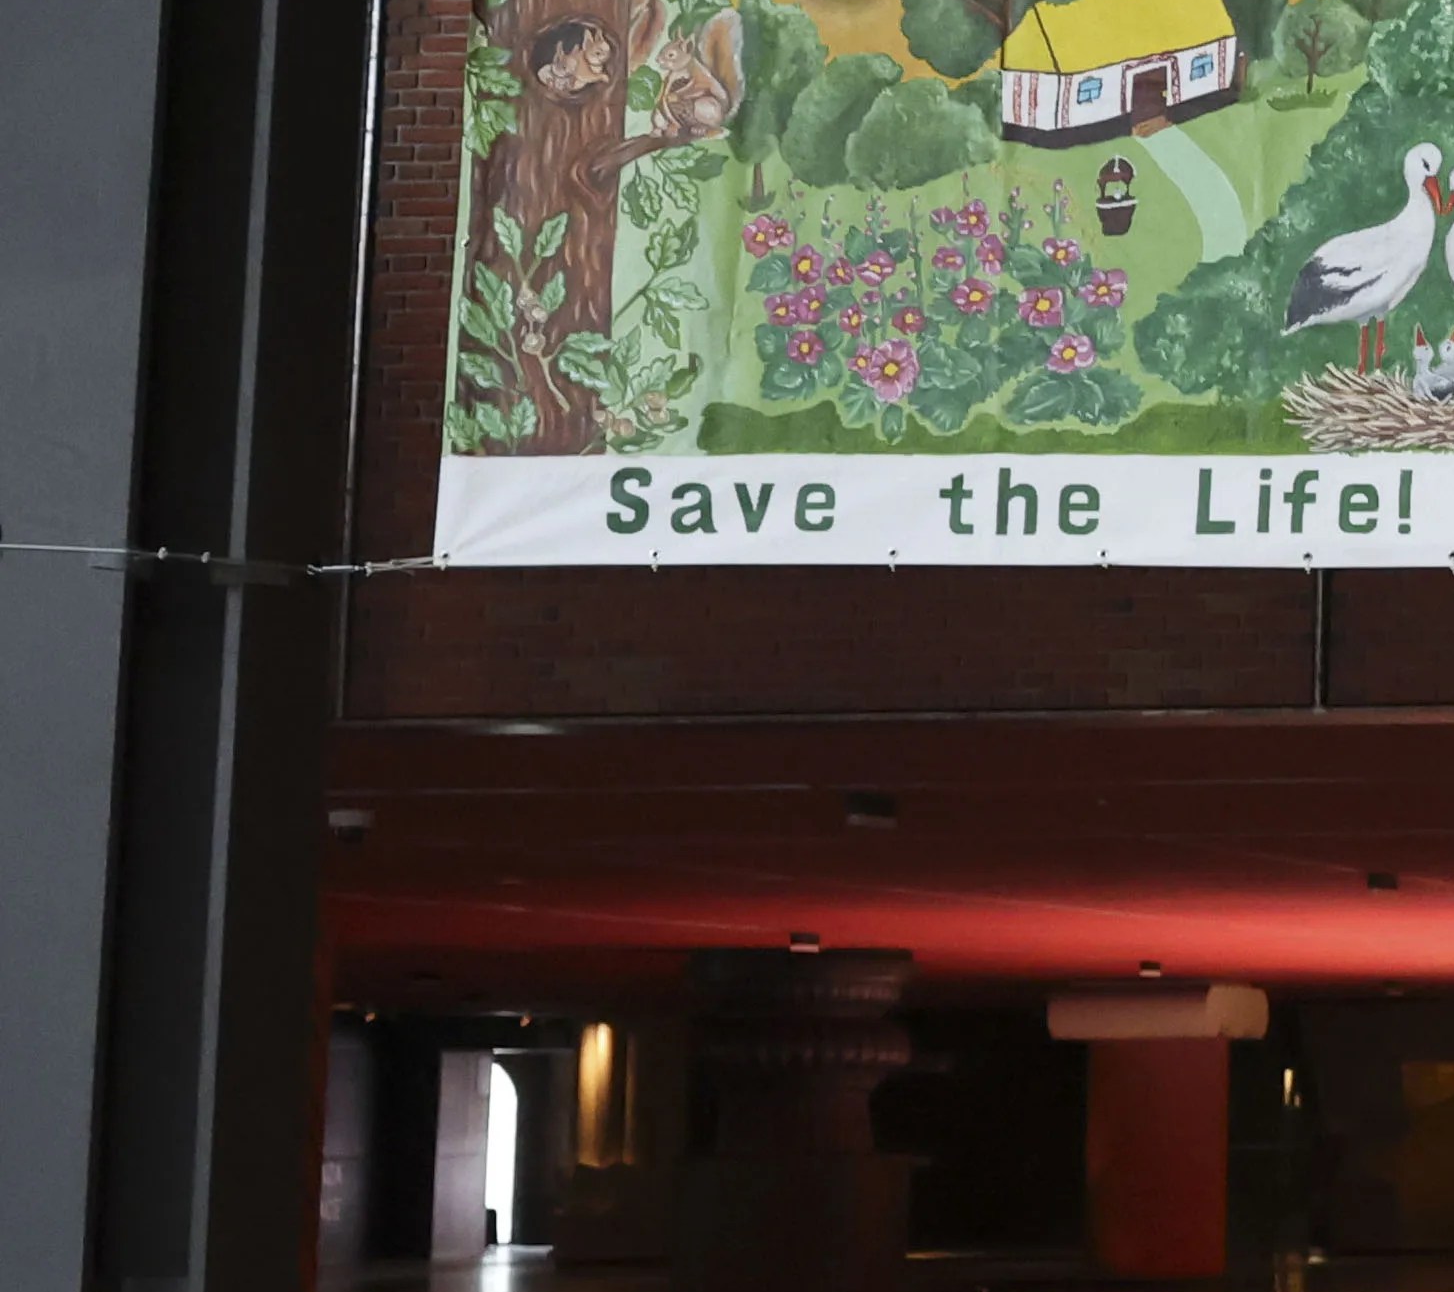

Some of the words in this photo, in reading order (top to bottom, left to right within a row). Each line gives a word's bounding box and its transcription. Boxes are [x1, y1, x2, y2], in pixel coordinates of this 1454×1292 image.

[606, 467, 836, 534] Save
[939, 468, 1102, 535] the
[1197, 468, 1413, 534] Life!
